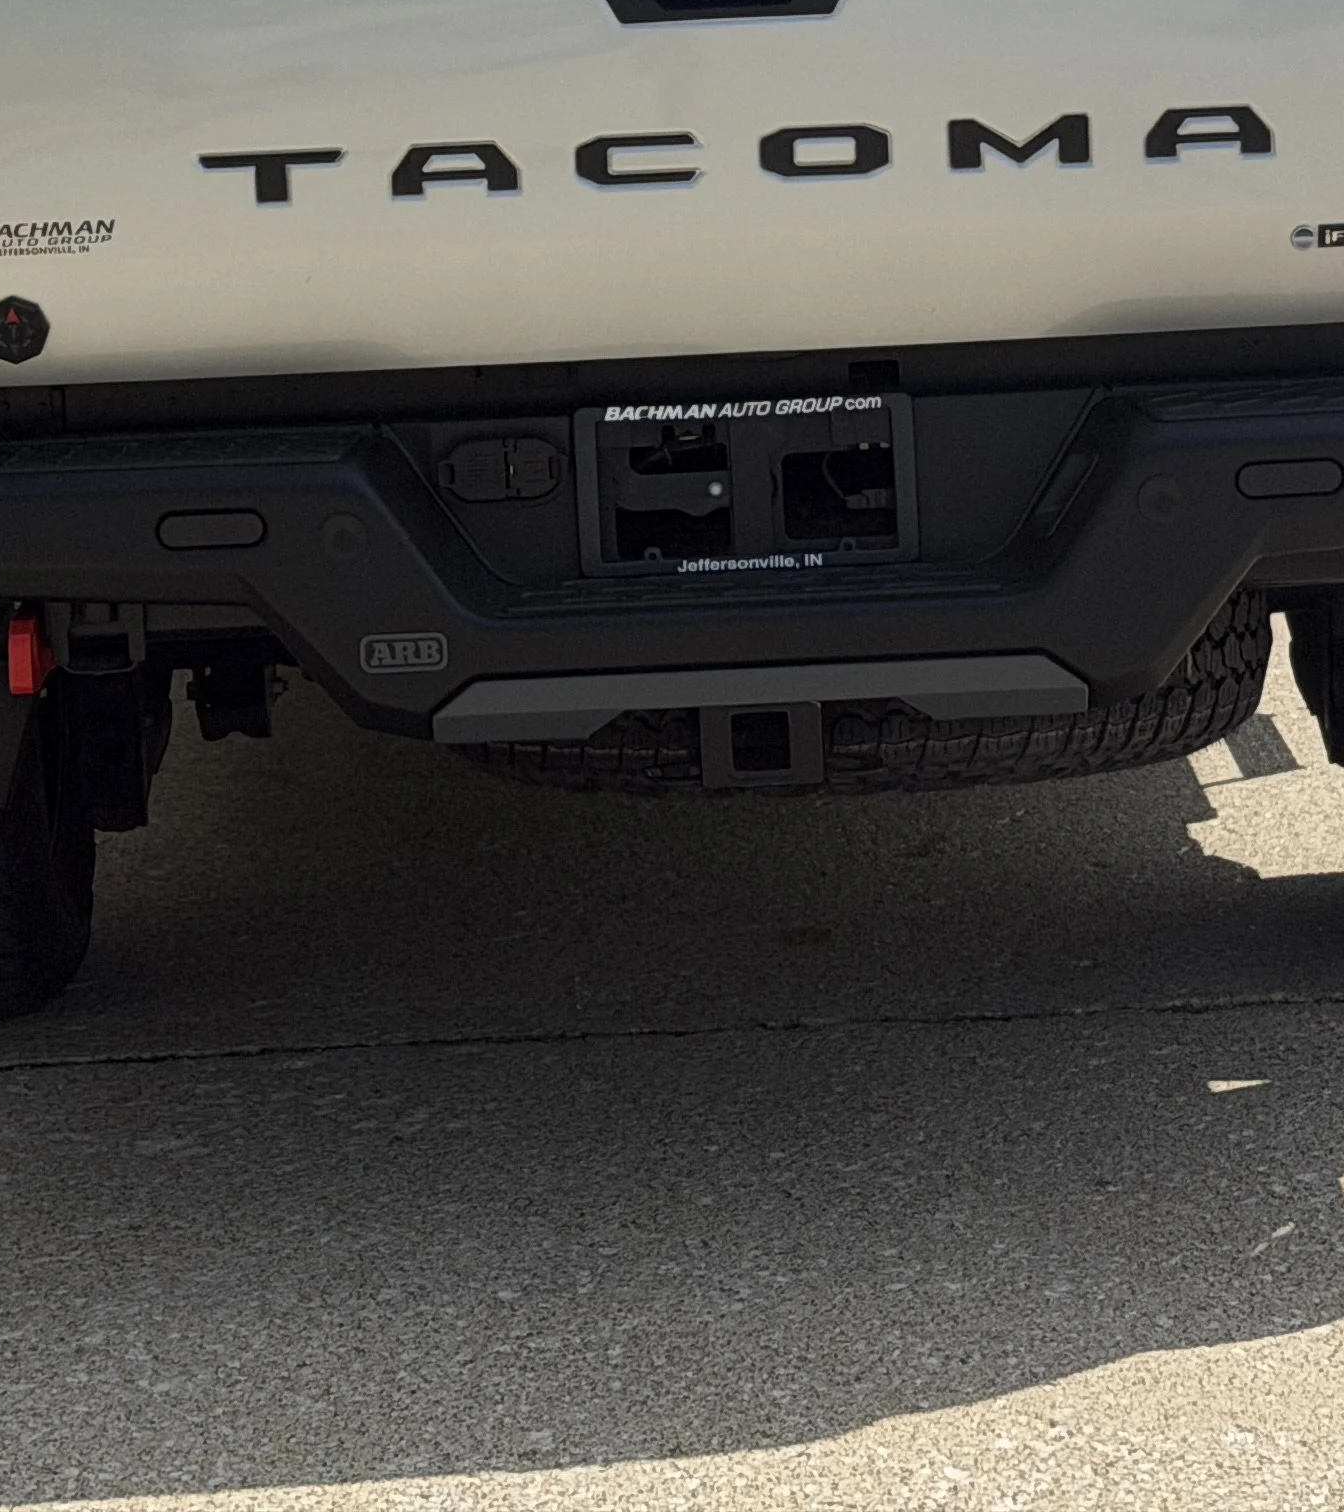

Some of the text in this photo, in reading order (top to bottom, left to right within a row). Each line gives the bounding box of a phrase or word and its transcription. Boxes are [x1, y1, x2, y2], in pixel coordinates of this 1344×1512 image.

[197, 104, 1275, 205] TACOMA
[47, 234, 113, 246] GROUP
[78, 244, 90, 254] IN
[604, 403, 716, 421] BACHMAN
[718, 400, 772, 418] AUTO
[677, 554, 823, 573] Jeffersonville, IN
[370, 640, 441, 666] ARB
